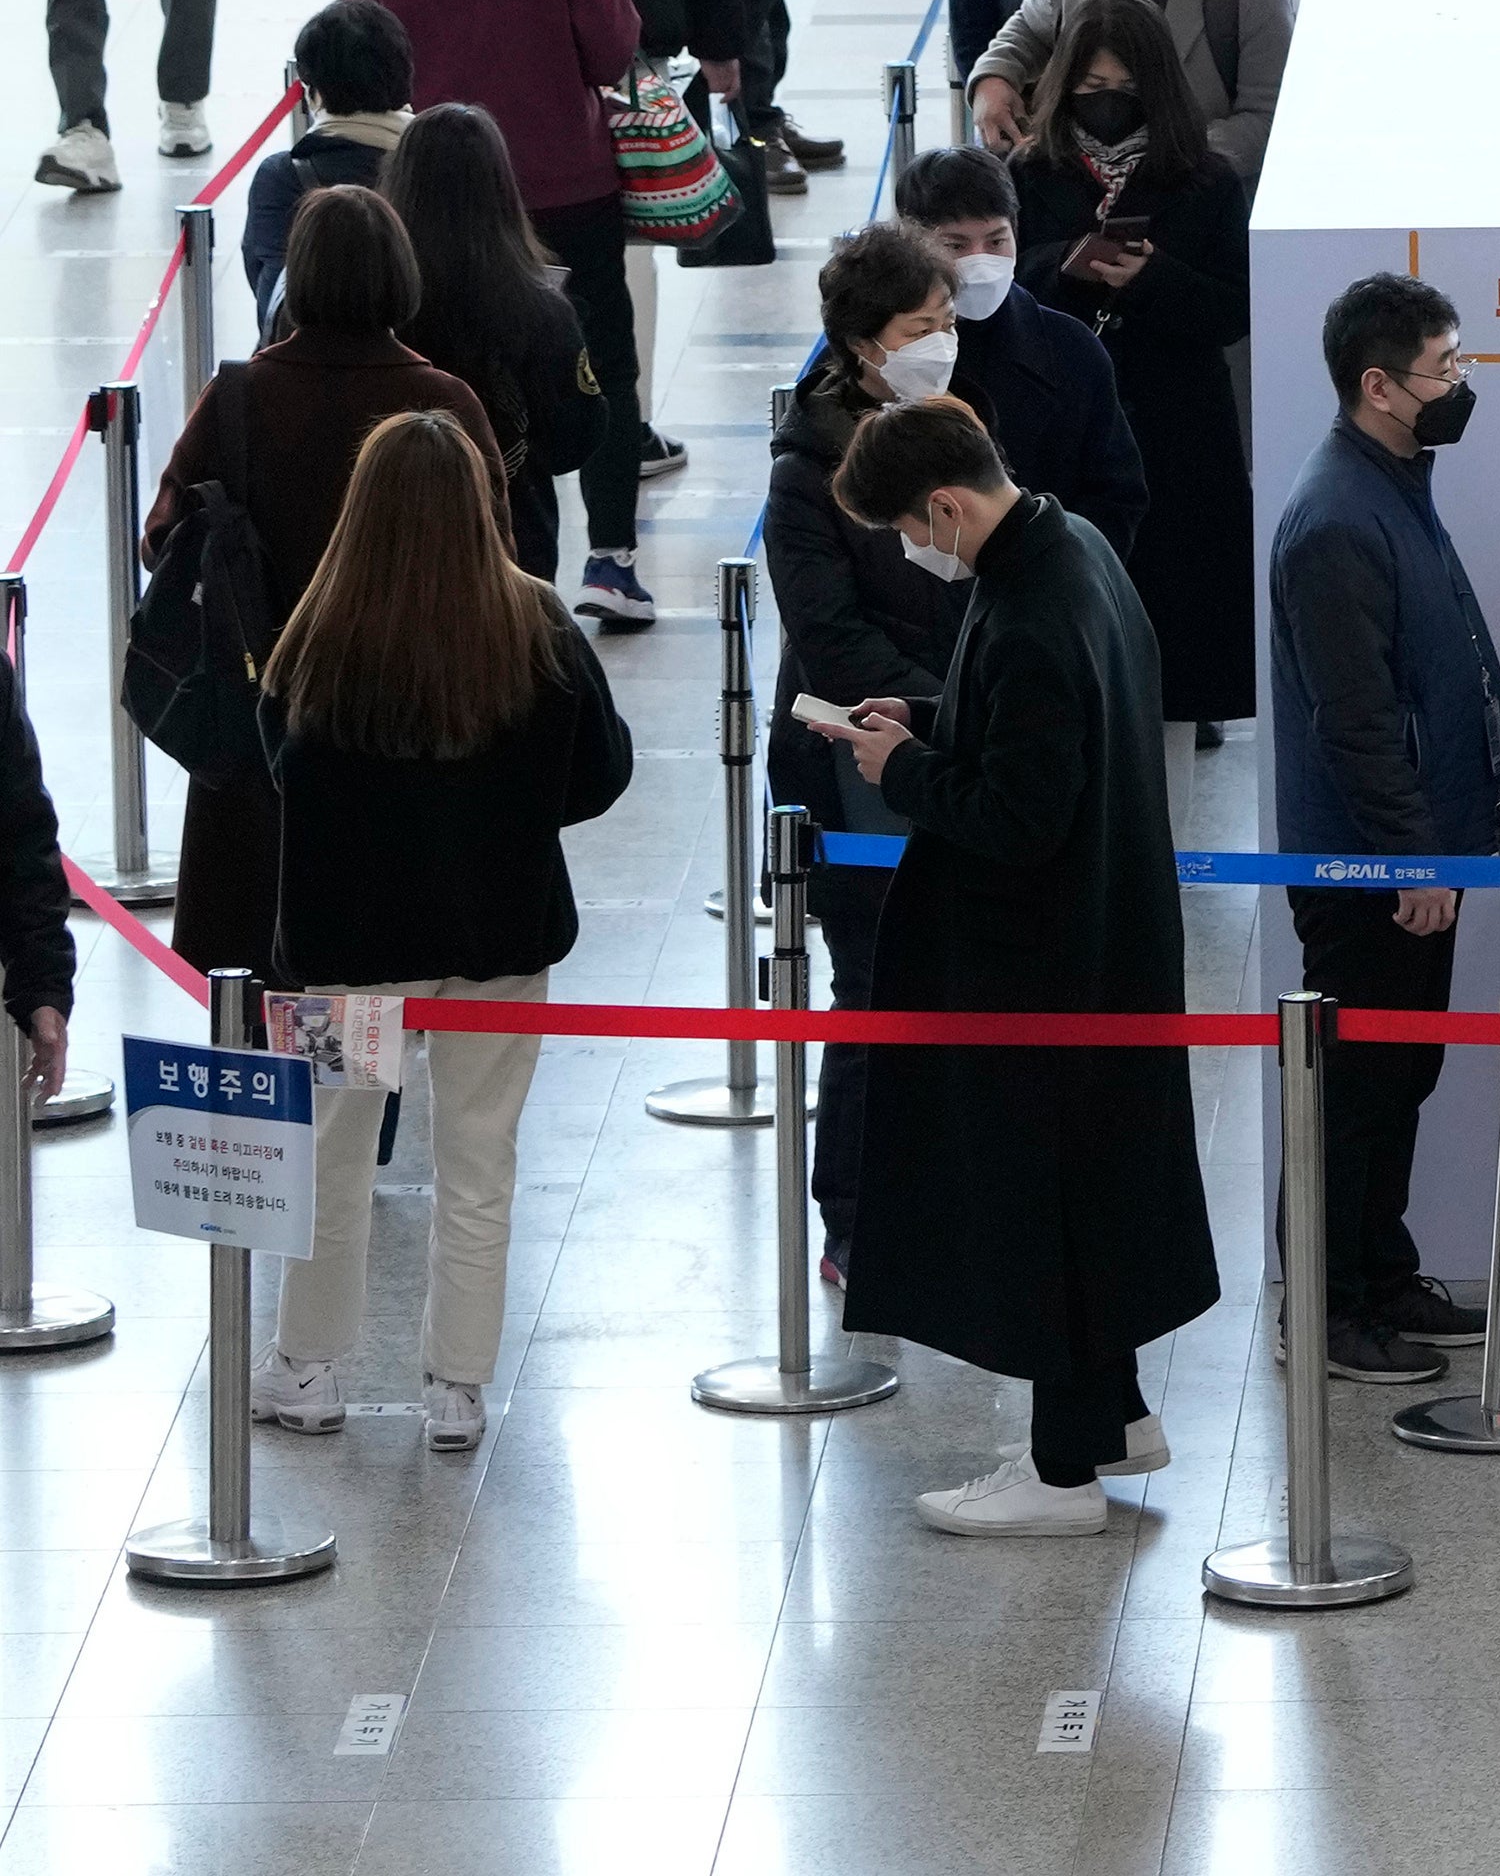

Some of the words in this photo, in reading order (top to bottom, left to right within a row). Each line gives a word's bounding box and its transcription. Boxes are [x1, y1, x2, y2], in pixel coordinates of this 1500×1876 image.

[1314, 859, 1390, 881] KORAIL
[158, 1060, 276, 1106] 보행주의
[172, 1158, 219, 1177] 주의하시기
[221, 1164, 264, 1184] 바랍니다.
[154, 1180, 180, 1197] 이용에
[213, 1190, 232, 1205] 드려
[350, 1703, 392, 1746] 거리두기
[1051, 1699, 1089, 1743] 거리두기
